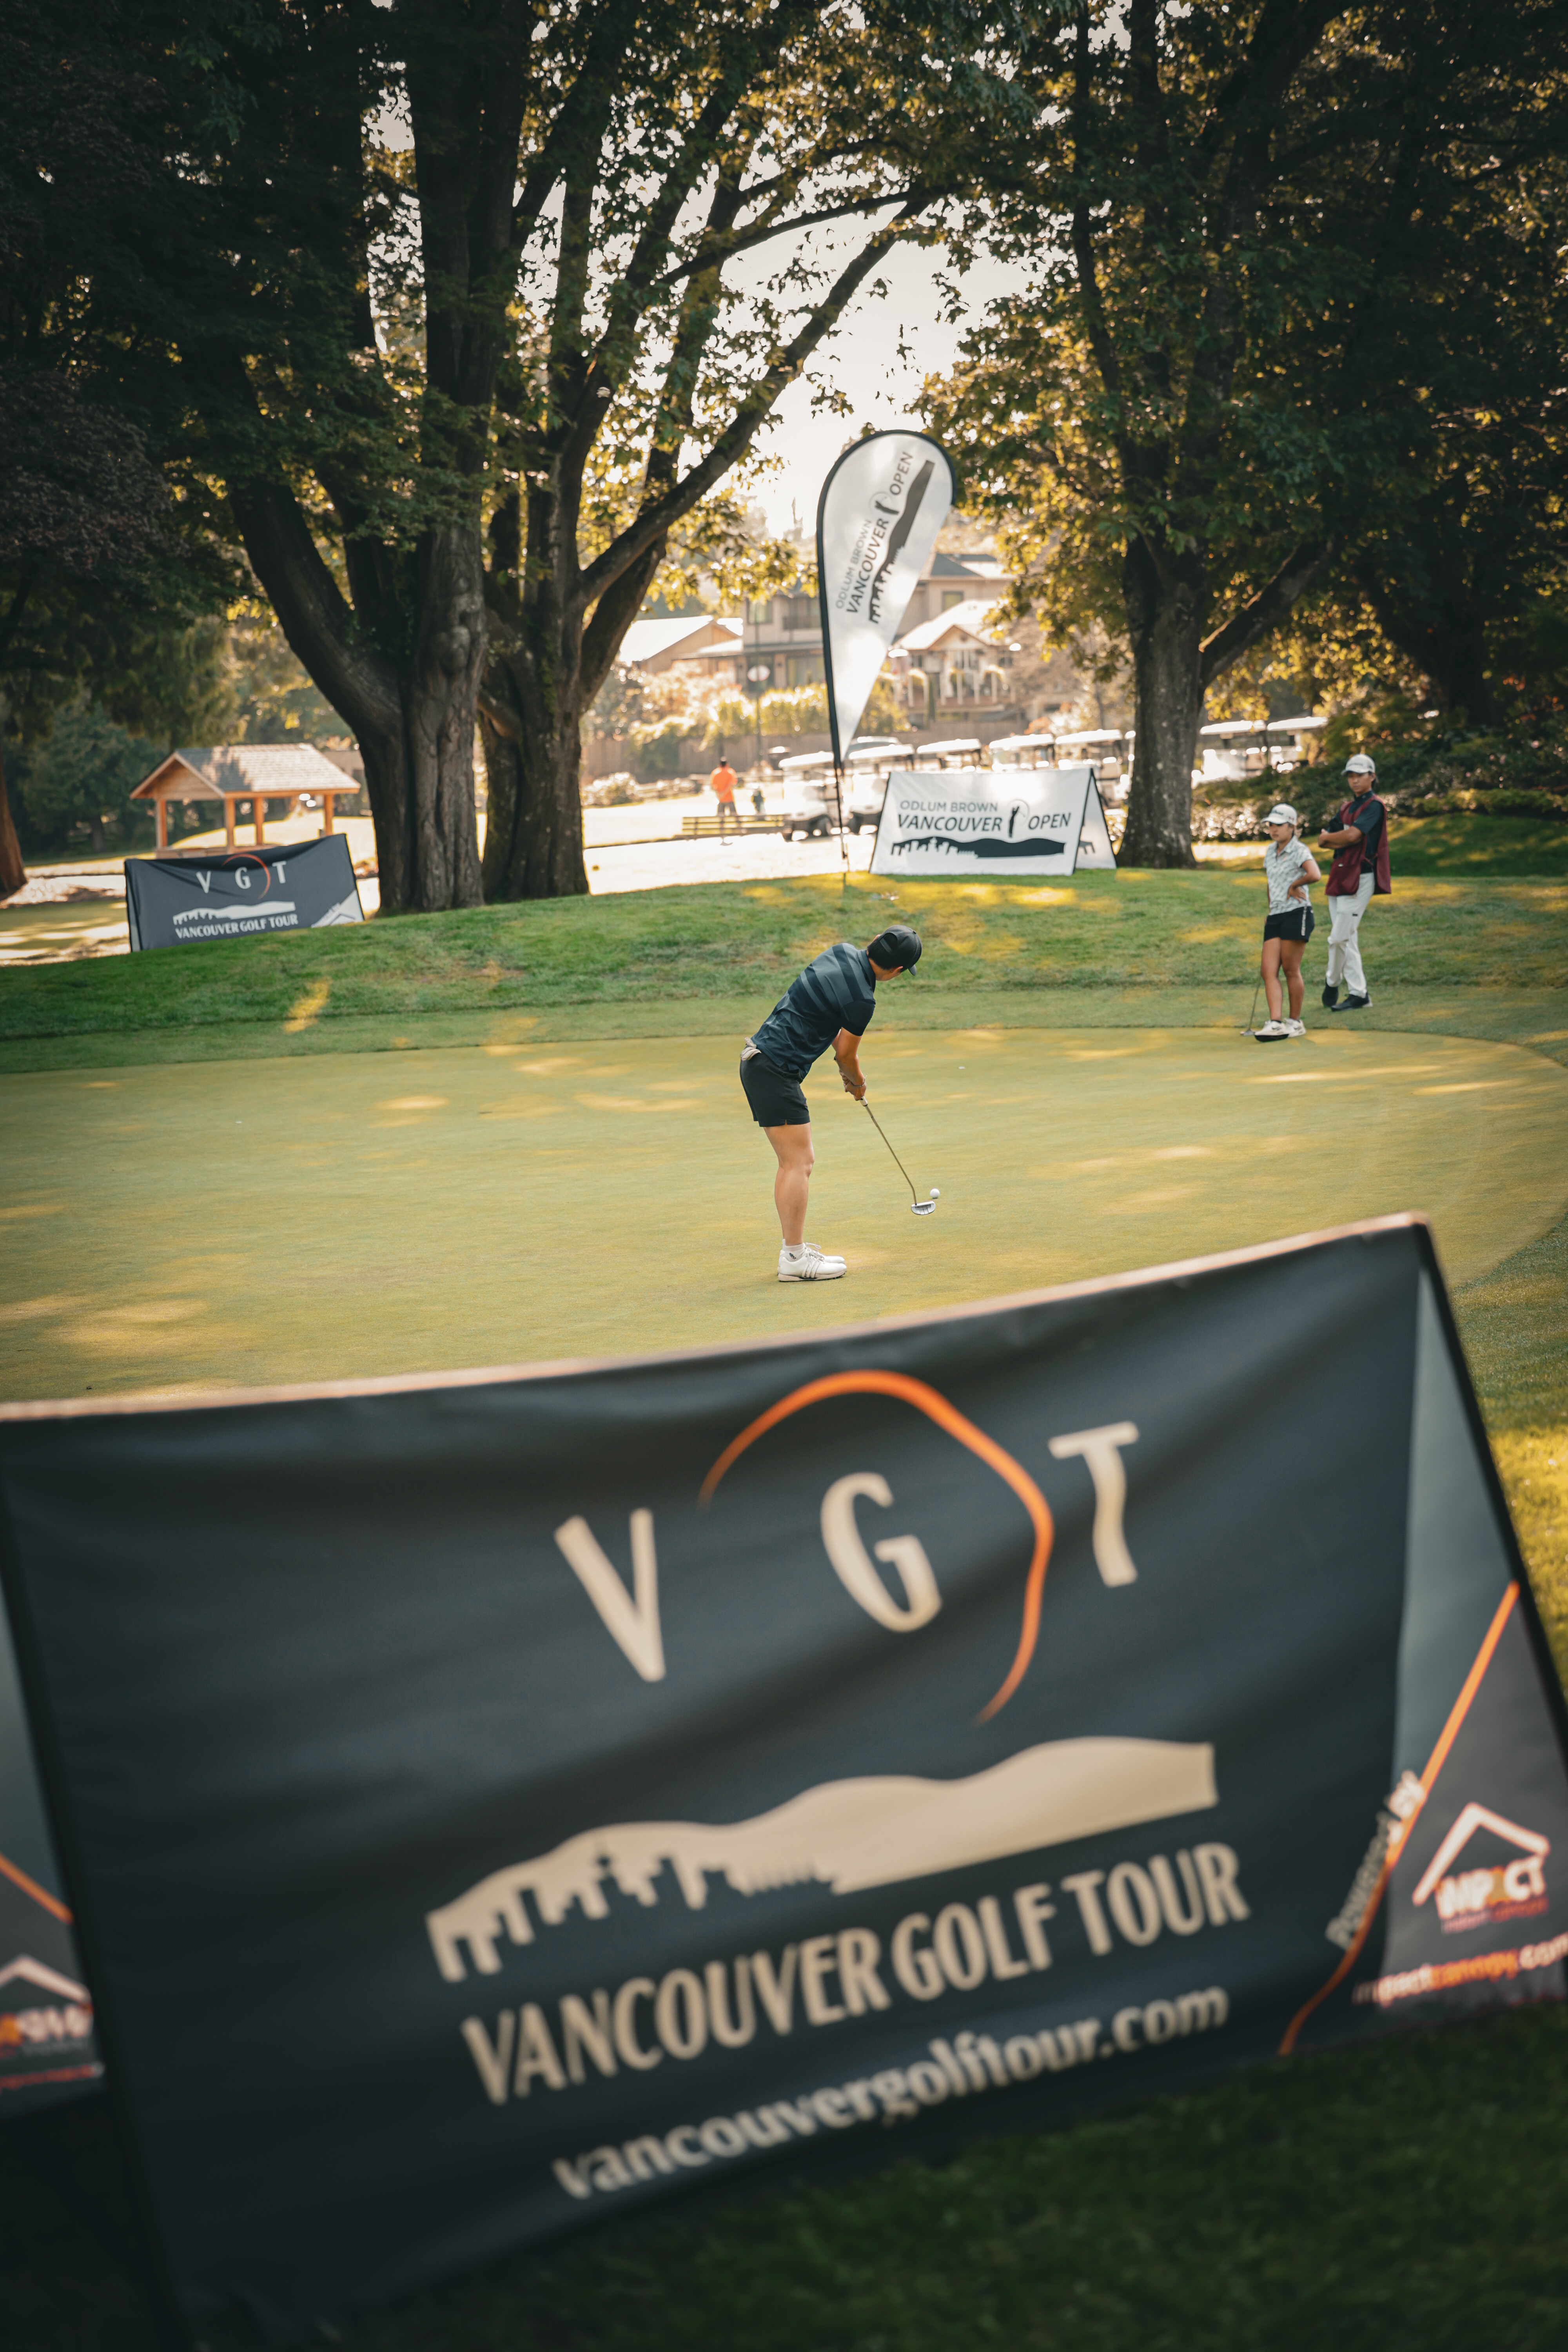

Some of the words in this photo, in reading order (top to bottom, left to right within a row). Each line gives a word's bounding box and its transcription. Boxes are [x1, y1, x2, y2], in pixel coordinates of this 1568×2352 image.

[836, 567, 855, 609] ODLUM
[850, 519, 873, 565] BROWN
[846, 517, 889, 614] VANCOUVER
[889, 451, 913, 496] OPEN
[898, 814, 1002, 831] VANCOUVER
[1028, 813, 1071, 830] OPEN
[900, 800, 946, 812] ODLUM
[951, 802, 998, 813] BROWN
[174, 922, 239, 939] VANCOUVER
[240, 917, 266, 933] GOLF
[269, 913, 298, 928] TOUR
[555, 1508, 665, 1682] V
[821, 1472, 942, 1633] G
[1049, 1421, 1139, 1587] T
[461, 1927, 892, 2106] VANCOUVER
[892, 1882, 1056, 2002] GOLF
[1062, 1842, 1250, 1955] TOUR
[553, 1987, 1231, 2200] vancouvergolftour.com
